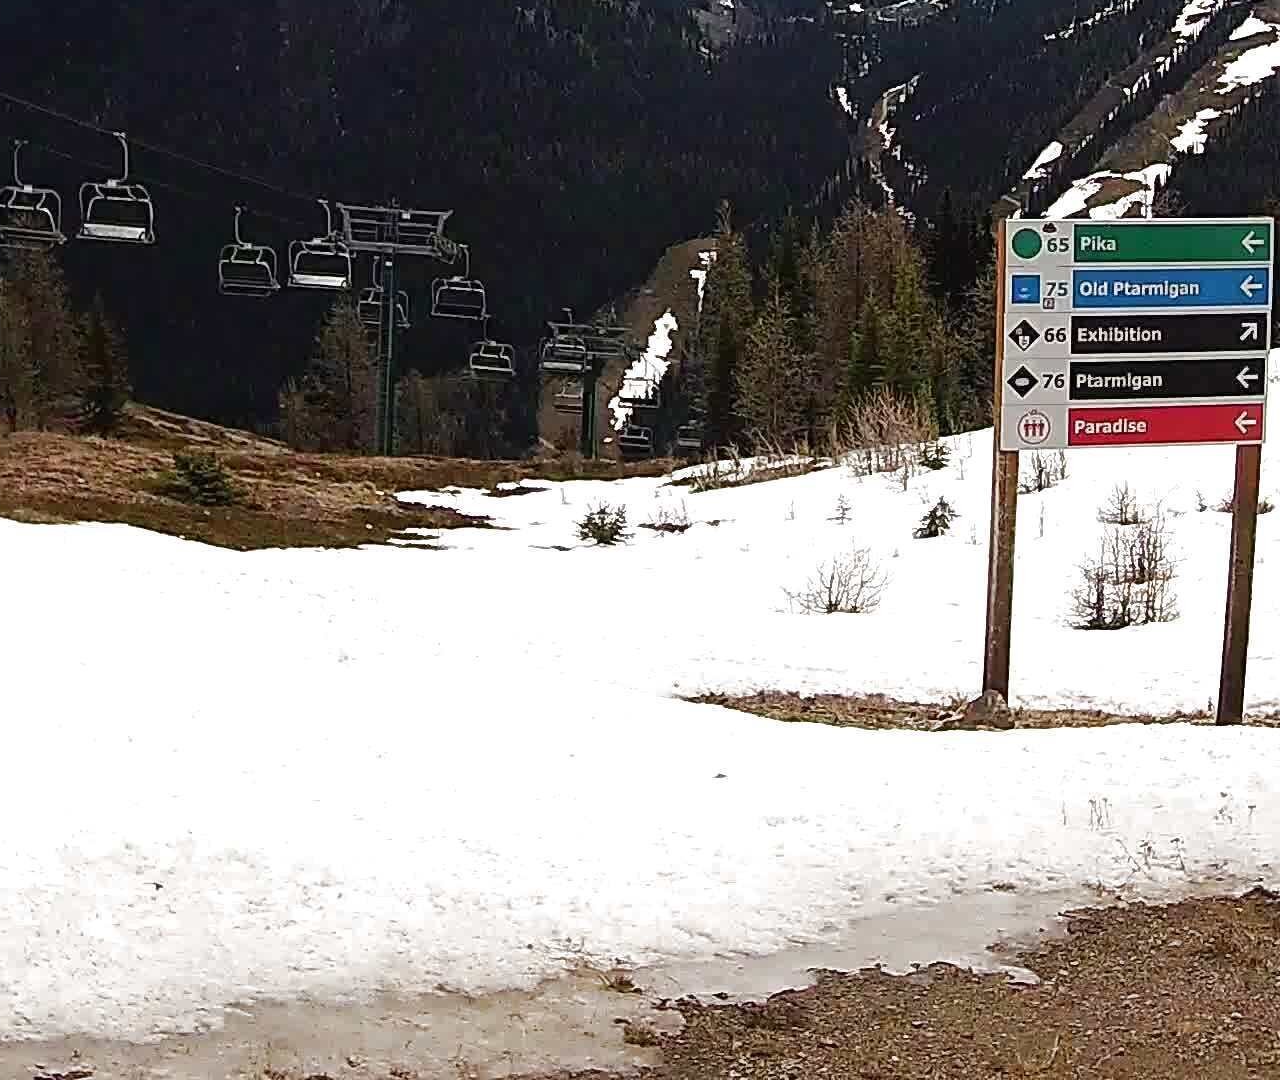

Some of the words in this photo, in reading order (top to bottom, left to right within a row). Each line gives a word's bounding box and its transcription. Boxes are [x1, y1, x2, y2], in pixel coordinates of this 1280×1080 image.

[1047, 237, 1069, 253] 65
[1080, 235, 1116, 251] Pika
[1045, 281, 1068, 297] 75
[1079, 280, 1108, 296] Old
[1113, 280, 1199, 299] Ptarmigan
[1044, 327, 1067, 343] 66
[1077, 326, 1162, 343] Exhibition
[1042, 373, 1065, 389] 76
[1076, 372, 1163, 392] Ptarmigan
[1074, 418, 1147, 435] Paradise
